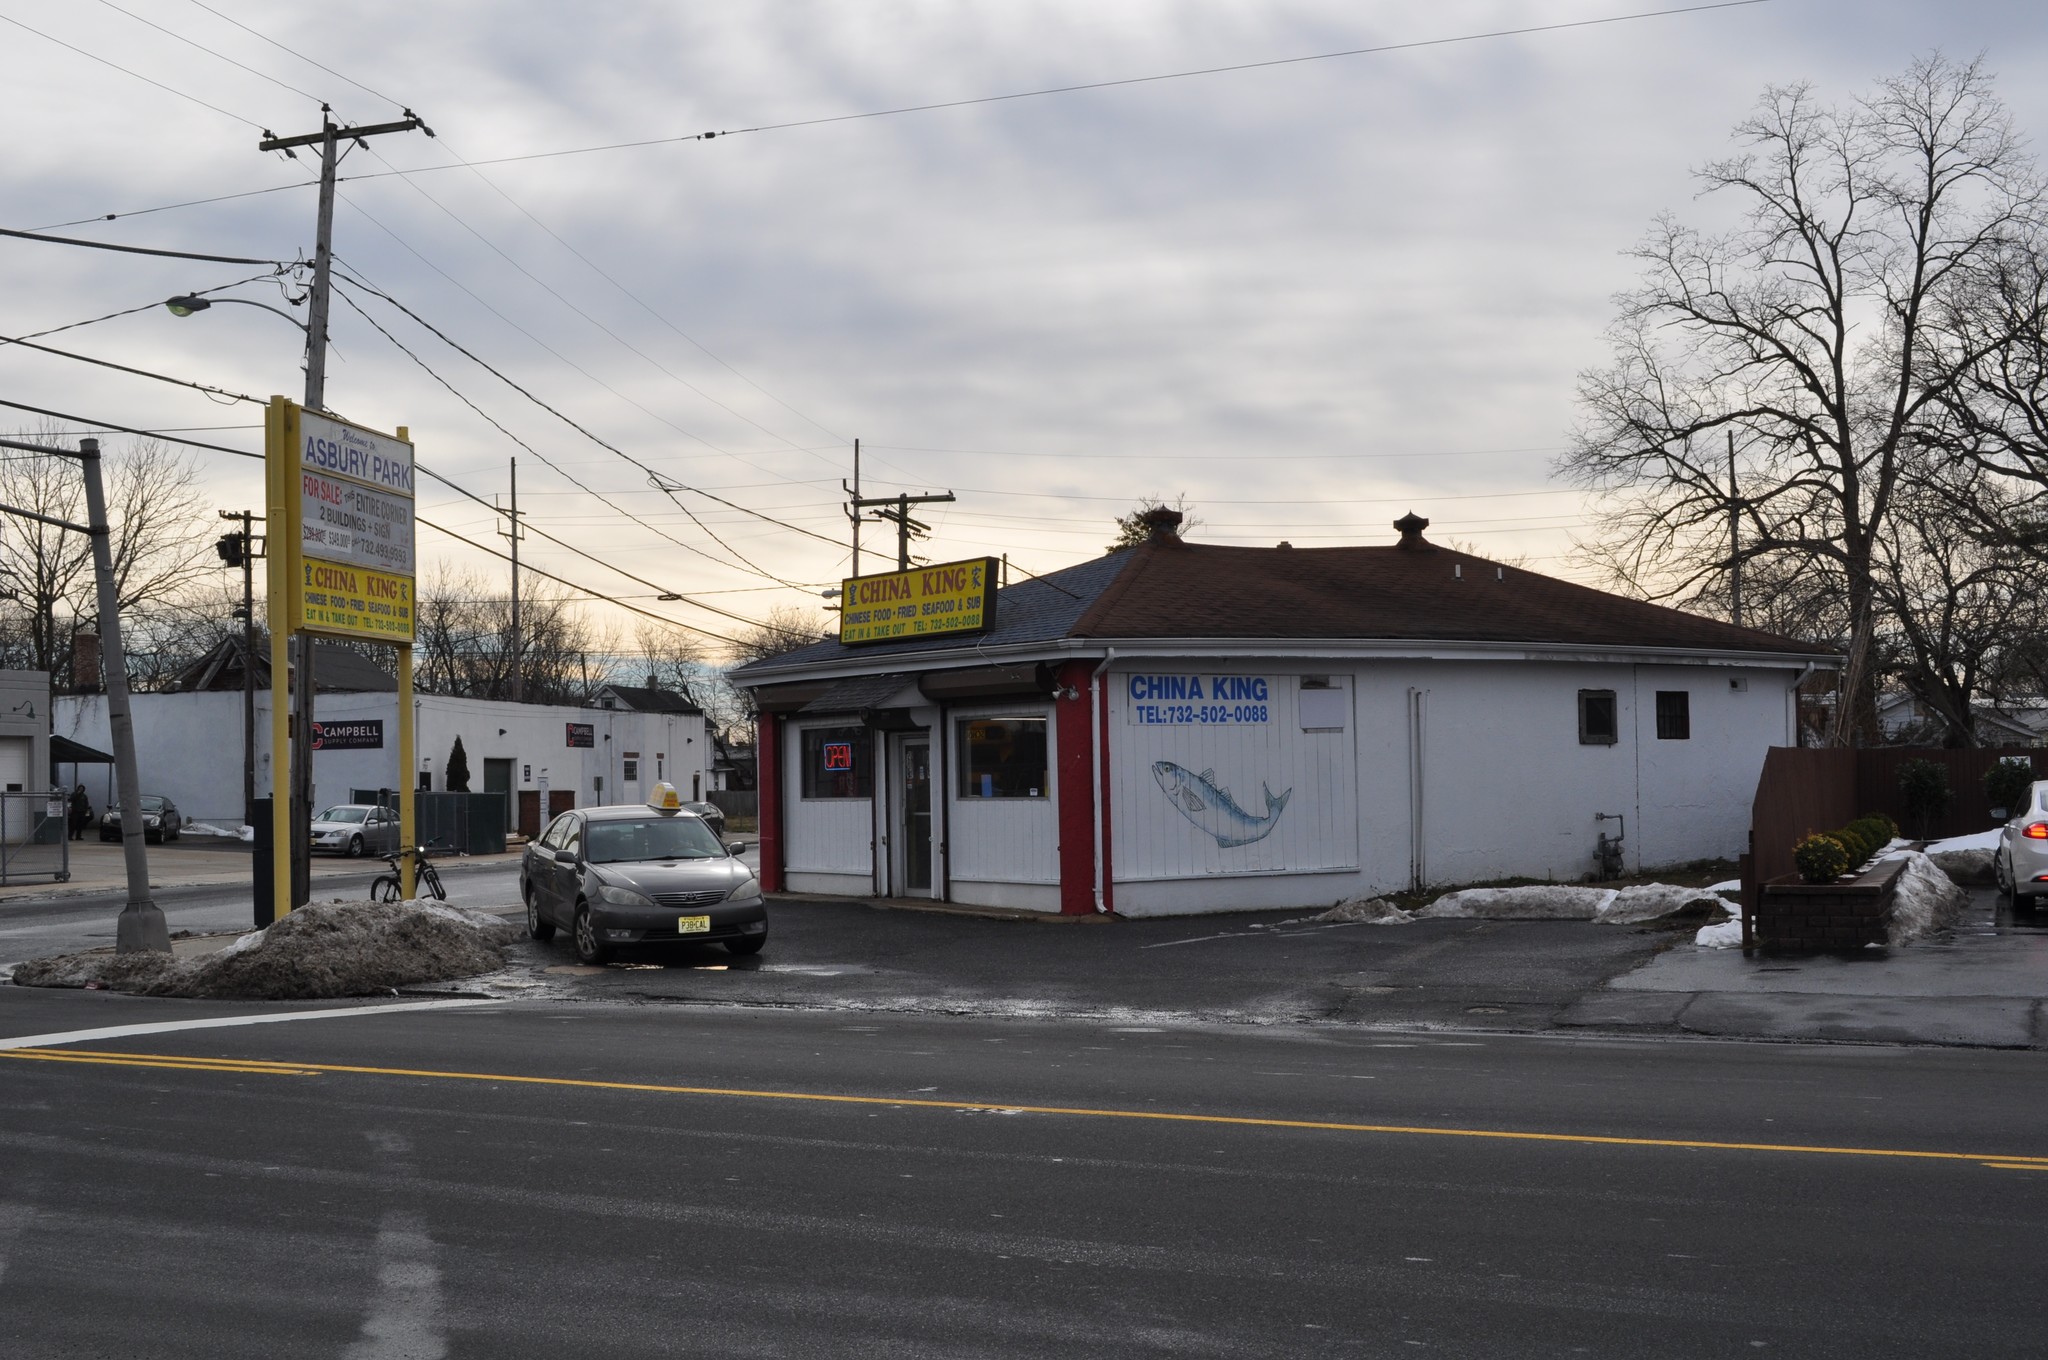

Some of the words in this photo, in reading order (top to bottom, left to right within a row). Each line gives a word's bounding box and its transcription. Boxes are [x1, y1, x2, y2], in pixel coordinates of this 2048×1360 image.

[342, 429, 368, 447] Welcome
[306, 435, 369, 477] ASBURY
[373, 455, 411, 489] PARK
[303, 474, 320, 498] FOR
[320, 481, 342, 505] SALE:
[356, 493, 380, 517] ENTIRE
[381, 501, 408, 526] CORNER
[320, 506, 325, 520] 2
[327, 508, 366, 532] BUILDINGS
[373, 522, 390, 539] SIGN
[361, 539, 407, 563] 732.493.9393
[315, 567, 358, 593] CHINA
[366, 575, 398, 599] KING
[860, 576, 912, 604] CHINA
[921, 567, 967, 596] KING
[305, 591, 327, 606] CHINESE
[331, 595, 346, 609] FOOD
[350, 599, 365, 612] FRIED
[368, 601, 391, 616] SEAFOOD
[399, 607, 408, 618] SUB
[845, 611, 871, 625] CHINESE
[874, 608, 891, 622] FOOD
[897, 604, 917, 619] FRIED
[922, 599, 954, 616] SEAFOOD
[958, 601, 963, 610] &
[966, 596, 981, 609] SUB
[306, 608, 316, 620] EAT
[318, 610, 325, 621] IN
[332, 612, 346, 625] TAKE
[347, 615, 358, 626] OUT
[363, 617, 374, 628] TEL:
[844, 629, 855, 640] EAT
[858, 628, 864, 639] IN
[874, 625, 890, 636] TAKE
[893, 623, 906, 635] OUT
[913, 620, 927, 632] TEL:
[930, 614, 980, 630] 732-502-0088
[1130, 675, 1204, 700] CHINA
[1212, 676, 1268, 701] KING
[323, 726, 379, 737] CAMPBELL
[826, 745, 850, 768] OPEN
